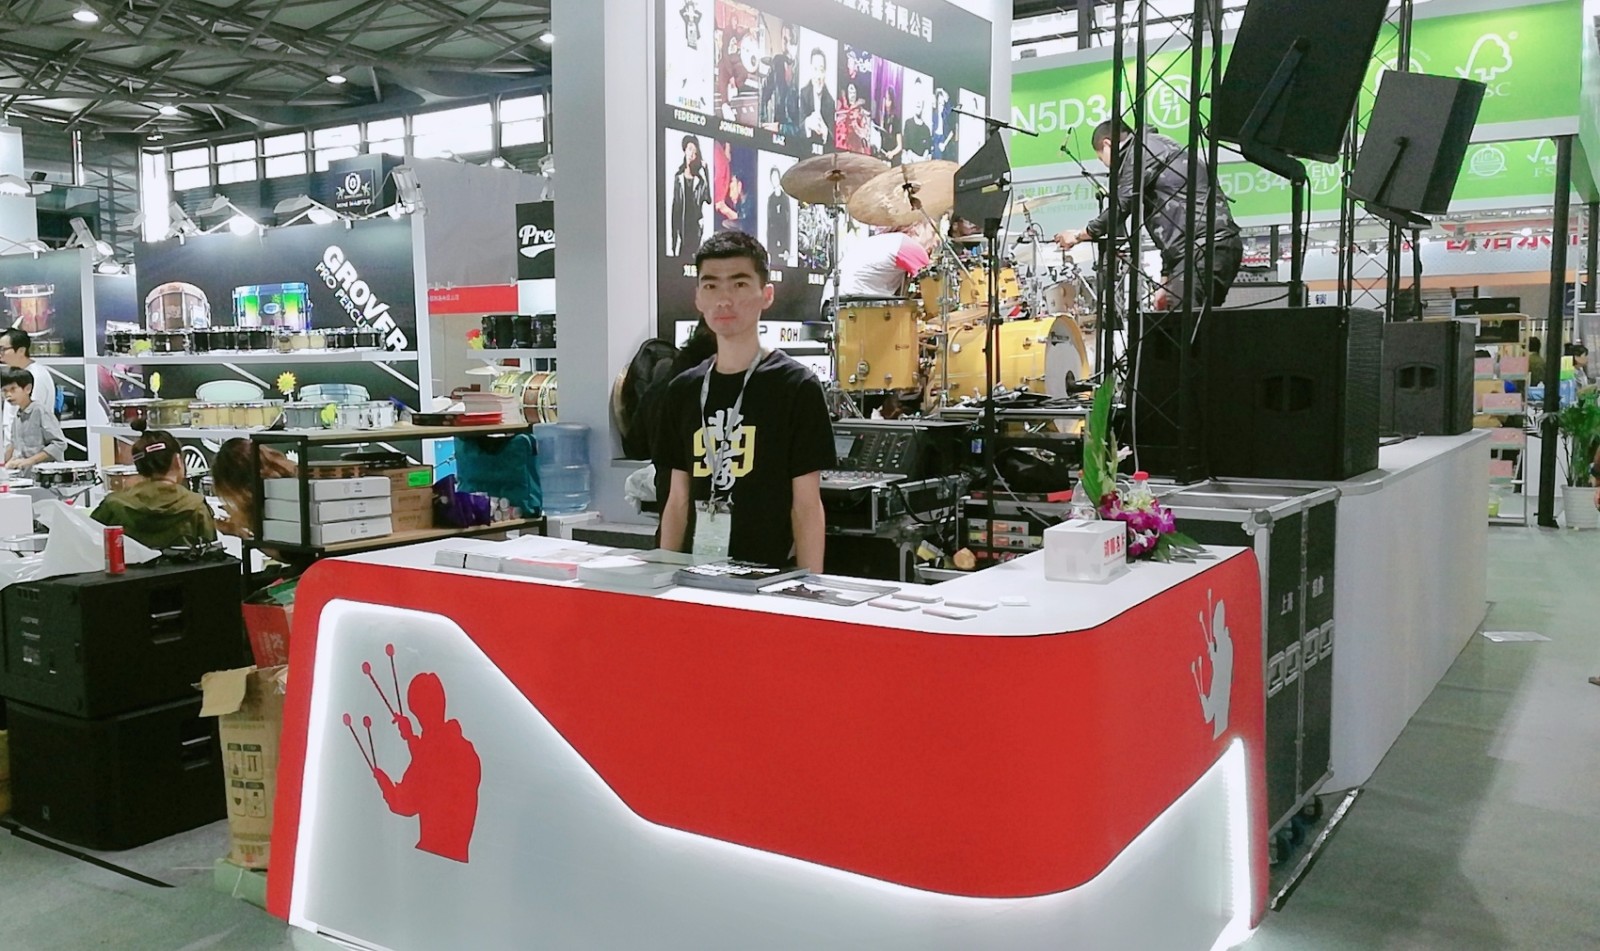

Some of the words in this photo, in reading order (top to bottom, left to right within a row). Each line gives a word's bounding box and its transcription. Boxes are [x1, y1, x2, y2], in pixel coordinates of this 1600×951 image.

[1486, 82, 1511, 98] SC
[674, 109, 706, 126] FEDERICO
[1160, 104, 1182, 123] 71
[1533, 167, 1556, 178] FS
[1219, 169, 1289, 196] 5D34
[315, 262, 337, 289] PRO
[323, 245, 408, 351] GROVER
[780, 327, 801, 342] ROH
